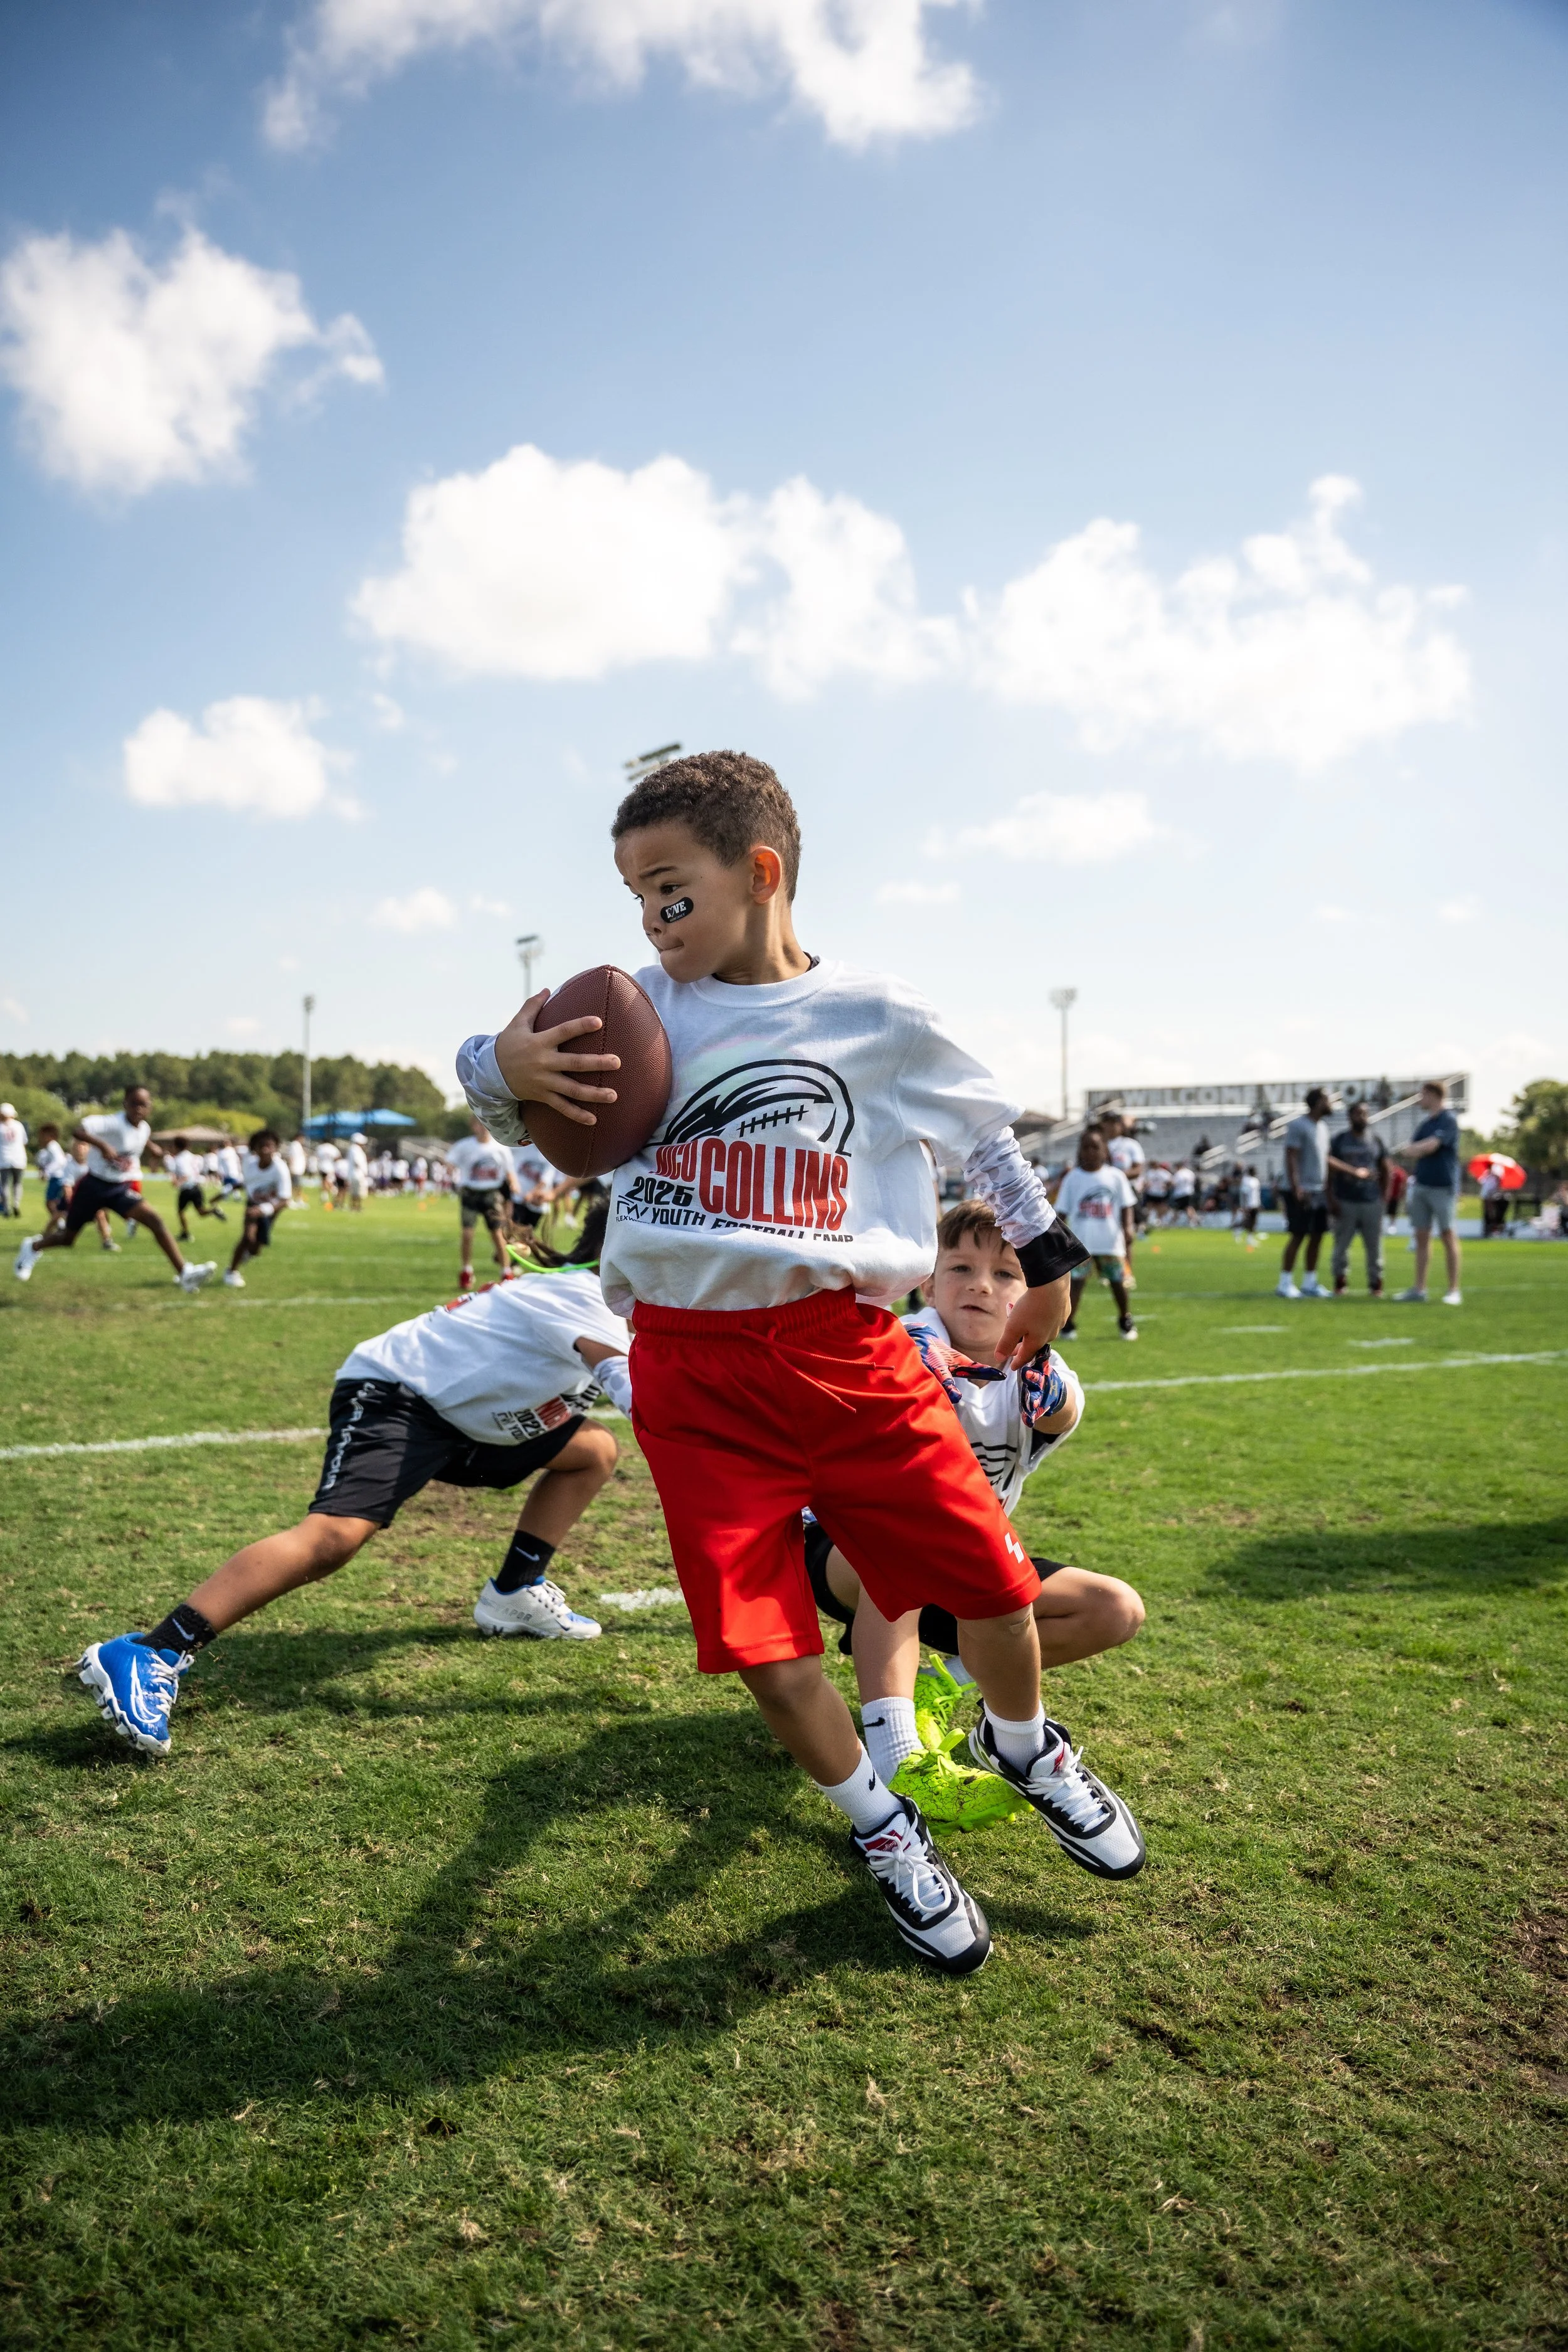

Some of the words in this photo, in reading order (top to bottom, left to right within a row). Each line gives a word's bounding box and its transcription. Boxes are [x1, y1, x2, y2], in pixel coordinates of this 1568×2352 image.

[625, 1176, 695, 1207] 2025
[649, 1139, 698, 1182] NICO
[699, 1138, 849, 1231] COLLINS
[651, 1207, 706, 1226] YOUTH
